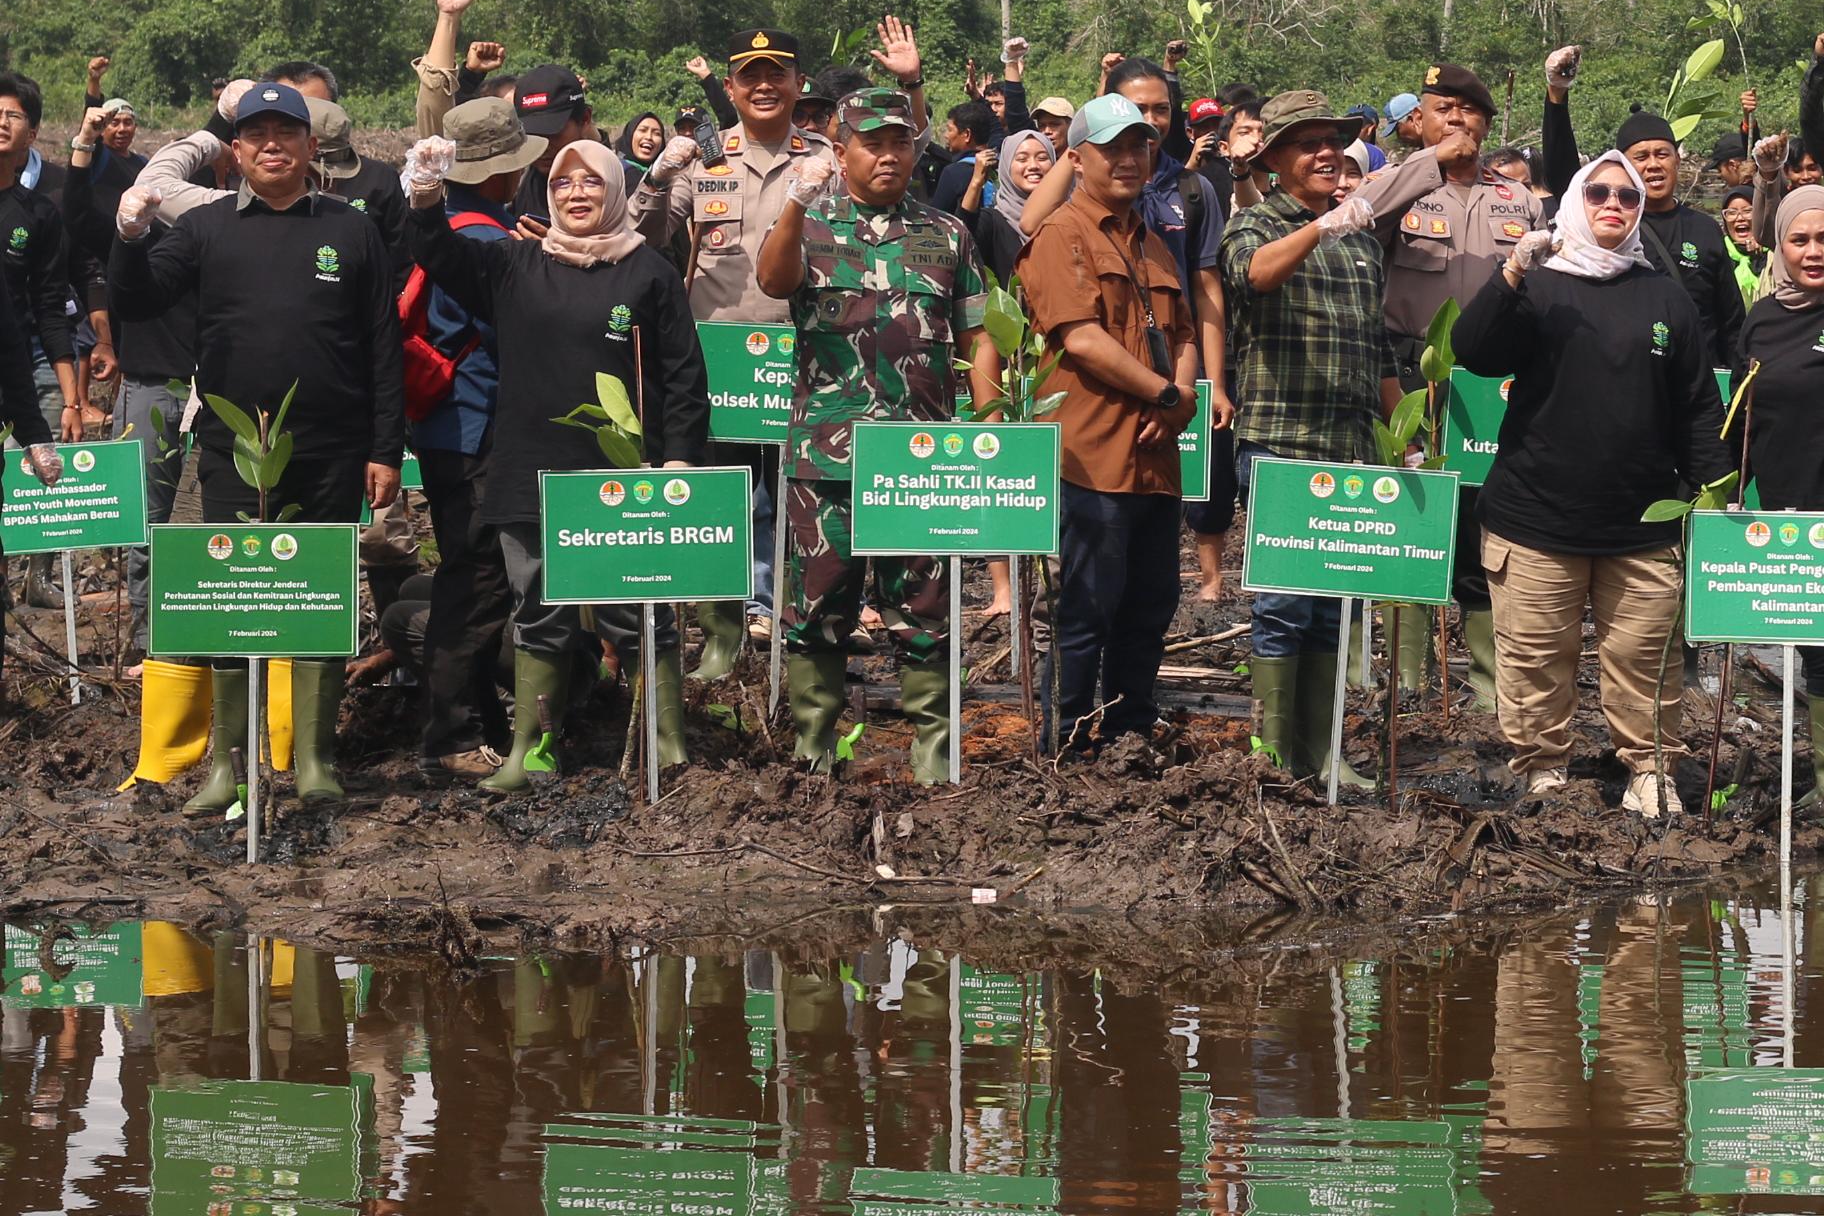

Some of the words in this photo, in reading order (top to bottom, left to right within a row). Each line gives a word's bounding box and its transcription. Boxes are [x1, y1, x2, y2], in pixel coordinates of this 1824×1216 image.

[523, 96, 547, 106] Supreme
[698, 181, 727, 192] DEDIK
[729, 181, 738, 192] IP
[1491, 204, 1526, 214] POLRI
[912, 255, 932, 263] TNI
[764, 394, 793, 410] Mu
[873, 474, 894, 488] Pa
[899, 474, 939, 489] Sahli
[944, 475, 981, 489] TK.II
[986, 475, 1036, 490] Kasad
[13, 488, 43, 498] Green
[46, 484, 106, 495] Ambassador
[2, 503, 31, 512] Green
[33, 500, 62, 510] Youth
[65, 496, 118, 507] Movement
[862, 492, 889, 506] Bid
[895, 492, 990, 509] Lingkungan
[996, 493, 1046, 510] Hidup
[1330, 505, 1357, 513] Ditanam
[4, 515, 38, 526] BPDAS
[41, 512, 87, 524] Mahakam
[90, 510, 119, 519] Berau
[1309, 517, 1350, 532] Ketua
[1354, 520, 1396, 535] DPRD
[558, 527, 664, 547] Sekretaris
[670, 526, 733, 544] BRGM
[1256, 534, 1314, 550] Provinsi
[1318, 539, 1399, 557] Kalimantan
[1403, 545, 1446, 560] Timur
[230, 565, 257, 573] Ditanam
[258, 565, 274, 573] Oleh
[1329, 563, 1356, 571] Februari
[1701, 562, 1746, 575] Kepala
[1749, 563, 1786, 574] Pusat
[1708, 581, 1802, 595] Pembangunan
[164, 592, 211, 600] Perhutanan
[212, 592, 236, 600] Sosial
[237, 592, 252, 600] dan
[253, 592, 293, 600] Kemitraan
[295, 592, 340, 602] Lingkungan
[161, 603, 211, 611] Kementerian
[213, 603, 258, 612] Lingkungan
[259, 603, 283, 612] Hidup
[285, 603, 299, 611] dan
[301, 603, 343, 611] Kehutanan
